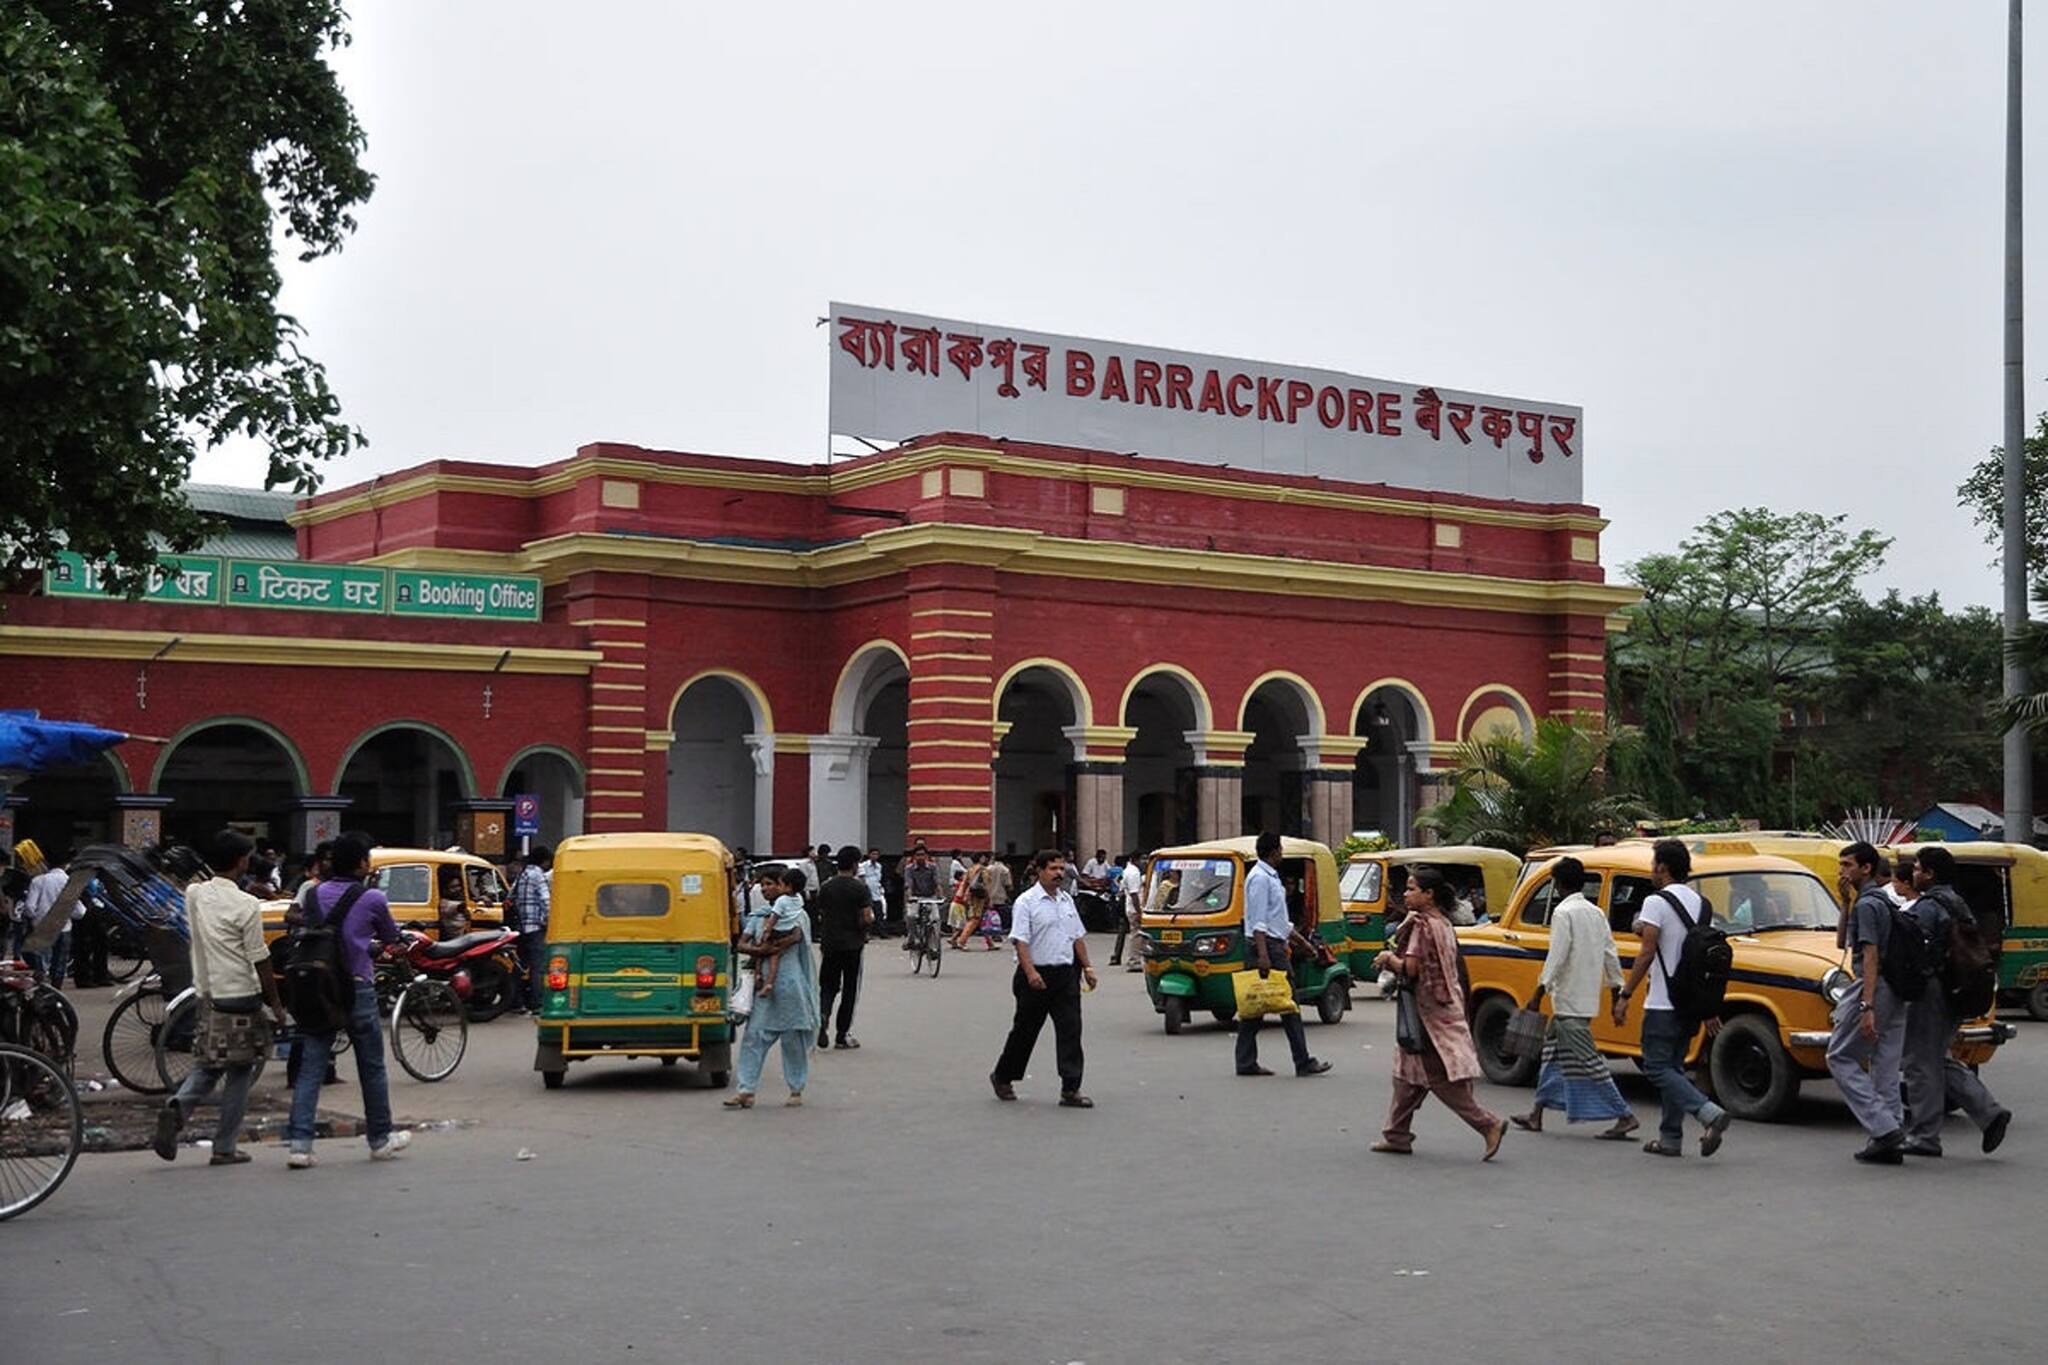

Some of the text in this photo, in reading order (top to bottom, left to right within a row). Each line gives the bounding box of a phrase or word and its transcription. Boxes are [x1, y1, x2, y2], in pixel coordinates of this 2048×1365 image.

[838, 317, 1050, 398] ব্যারাকপুর
[1066, 349, 1402, 436] BARRACKPORE
[1413, 387, 1576, 464] बैरकपुर
[258, 566, 381, 605] टिकट घर
[419, 579, 535, 612] Booking Office
